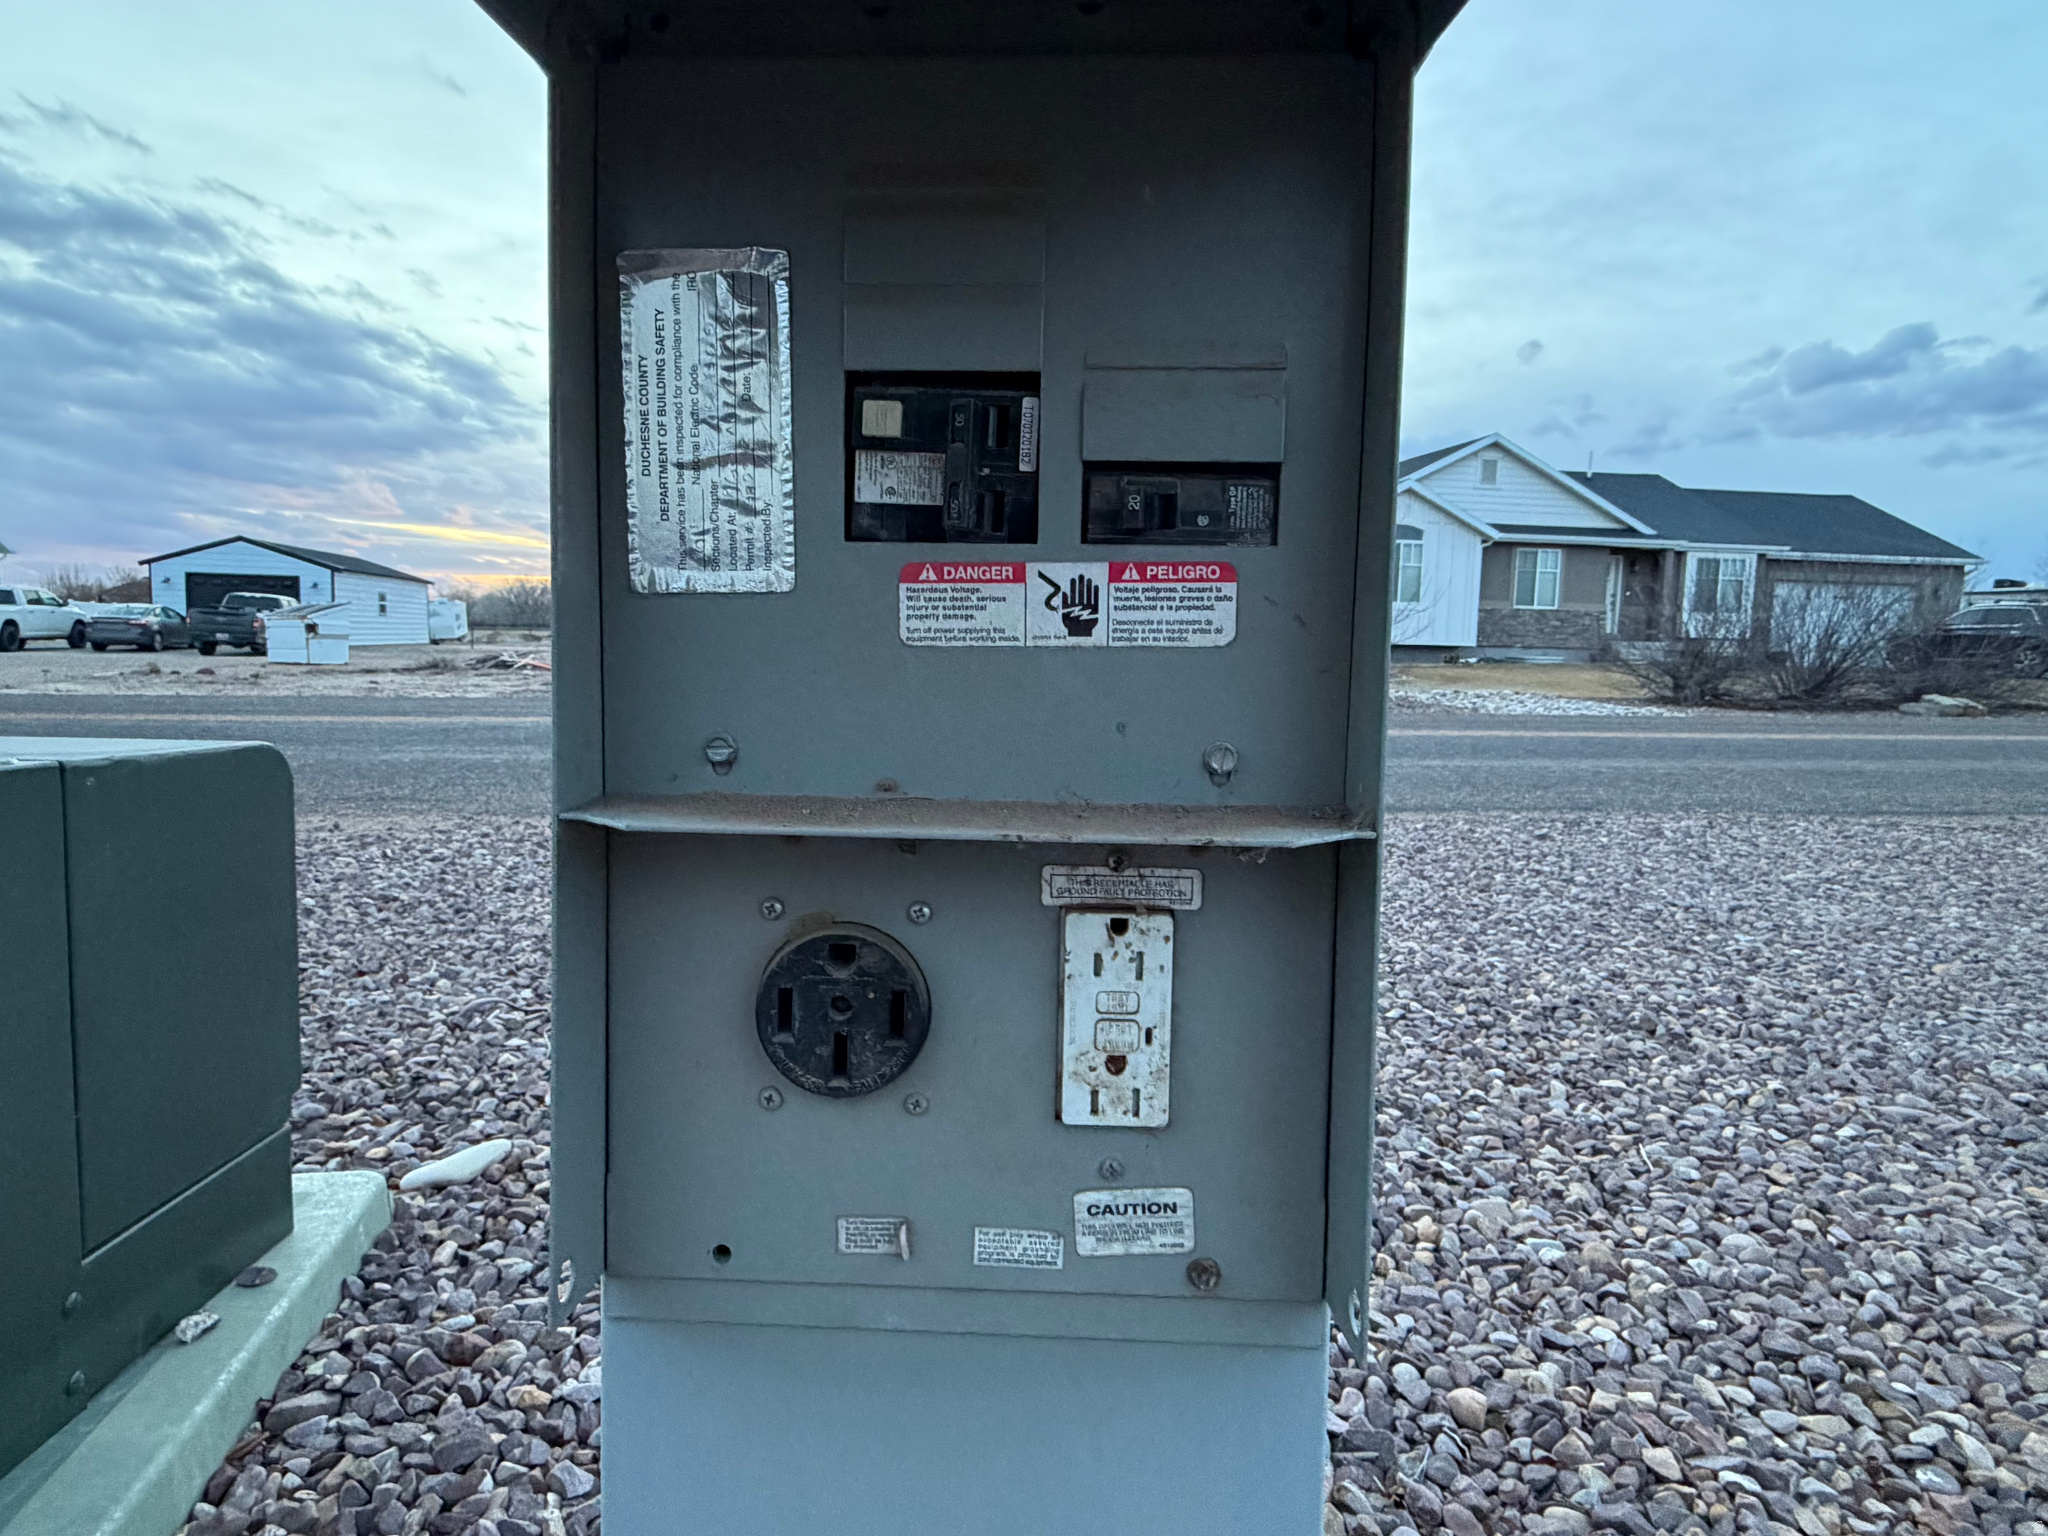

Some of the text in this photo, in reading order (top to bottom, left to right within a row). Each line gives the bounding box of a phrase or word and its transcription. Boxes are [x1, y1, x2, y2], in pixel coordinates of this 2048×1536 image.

[741, 371, 751, 402] Date:
[638, 354, 651, 477] DUCHESNE COUNTY
[654, 308, 670, 522] DEPARTMENT OF BUILDING SAFETY
[671, 273, 688, 572] This service has been inspected for compliance with the
[688, 364, 701, 485] National Electric Code
[1128, 494, 1140, 511] 20
[709, 479, 721, 572] Sections/Chapter
[728, 529, 738, 572] Located
[745, 537, 755, 571] Permit
[762, 519, 773, 571] Inspected
[943, 566, 1014, 580] DANGER
[1147, 565, 1220, 579] PELIGRO
[951, 586, 982, 595] Voltage.
[906, 613, 940, 622] property
[1056, 887, 1187, 897] GROUND FAULT PROTECTION
[1094, 877, 1153, 887] RECEPTACLE
[1155, 879, 1175, 888] HAS
[1086, 1202, 1178, 1216] CAUTION
